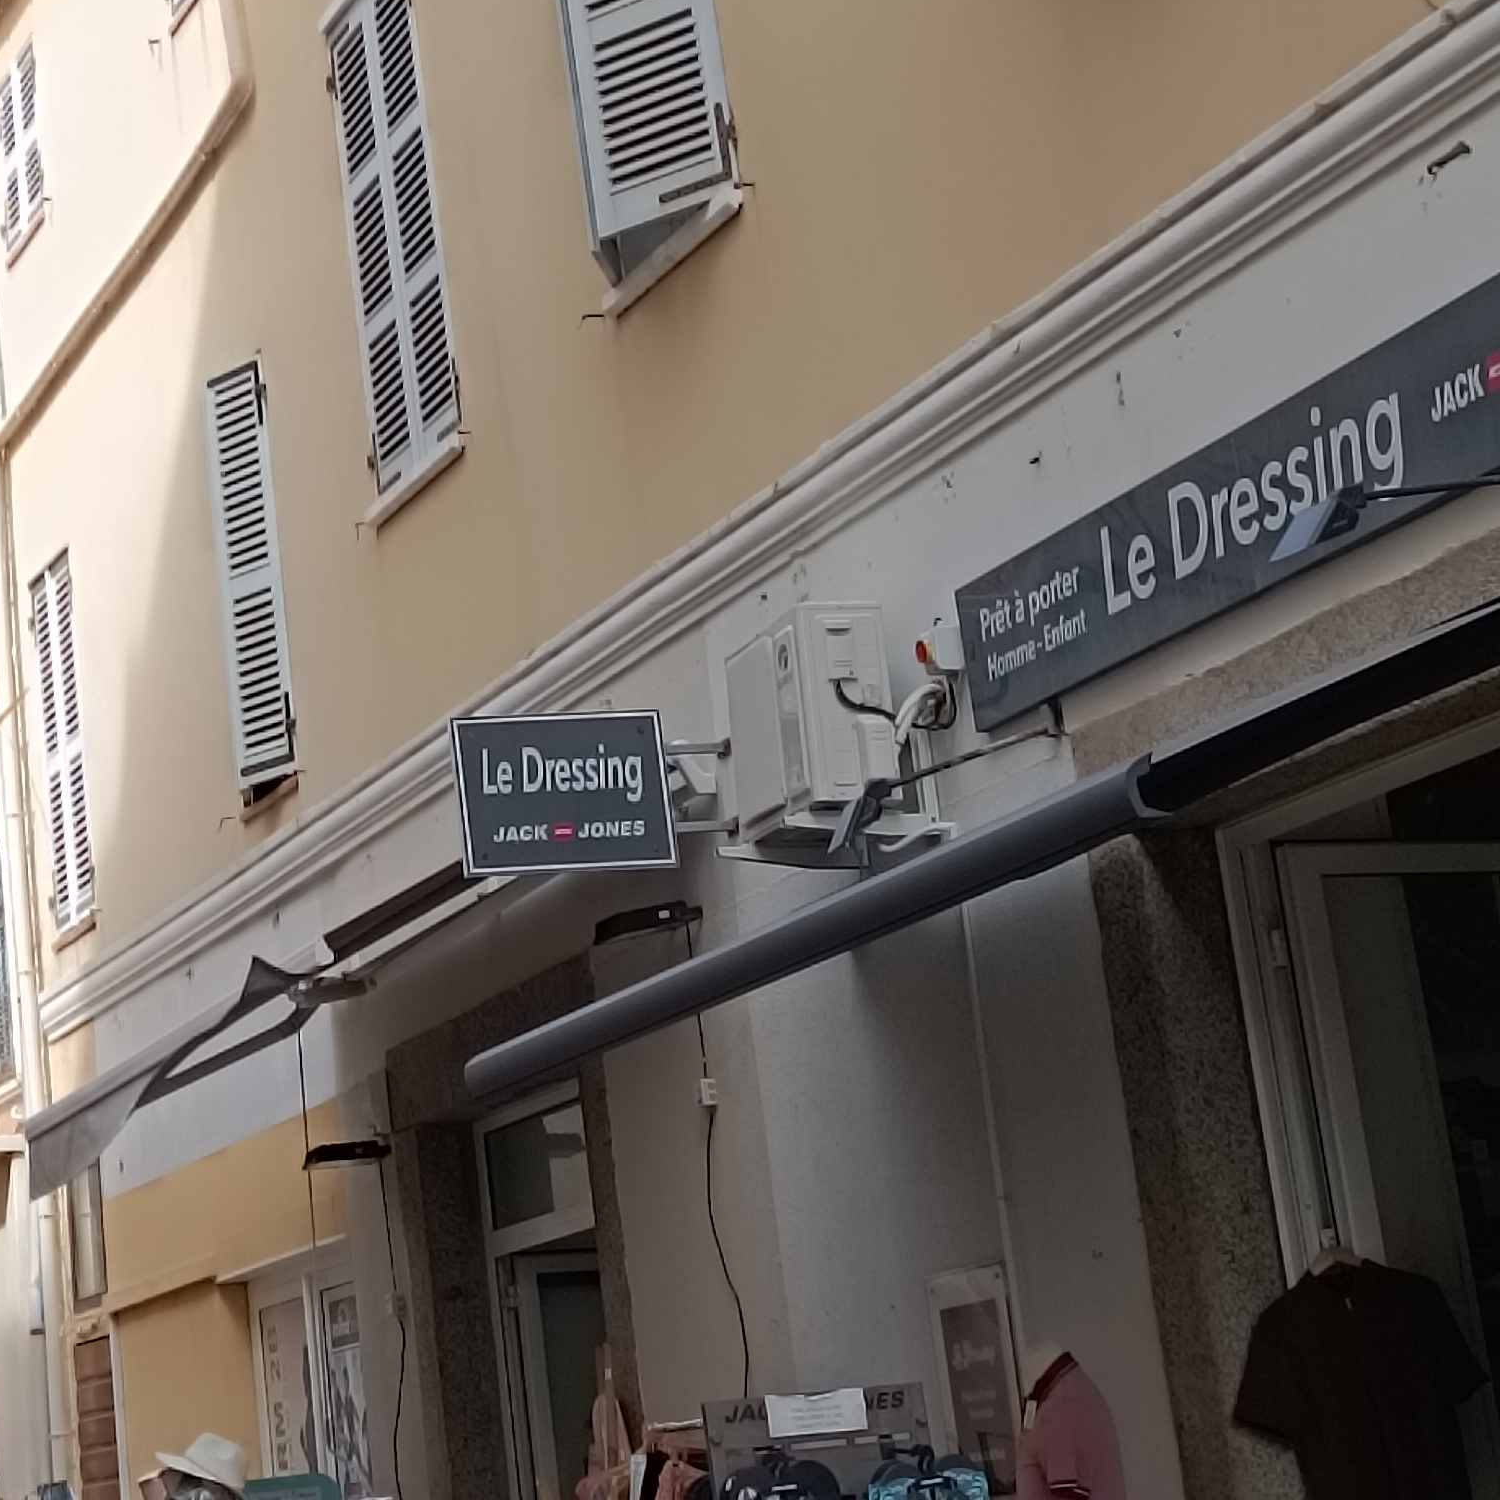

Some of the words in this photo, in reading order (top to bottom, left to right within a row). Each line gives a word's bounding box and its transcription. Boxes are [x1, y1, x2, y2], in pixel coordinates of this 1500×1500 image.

[1431, 363, 1485, 422] JACK
[1100, 525, 1157, 615] Le
[1167, 392, 1404, 580] Dressing
[979, 598, 1012, 642] Prêt
[1013, 588, 1025, 623] à
[1029, 566, 1079, 627] porter
[481, 747, 513, 795] Le
[521, 743, 644, 802] Dressing
[493, 823, 548, 843] JACK
[577, 820, 645, 839] JONES
